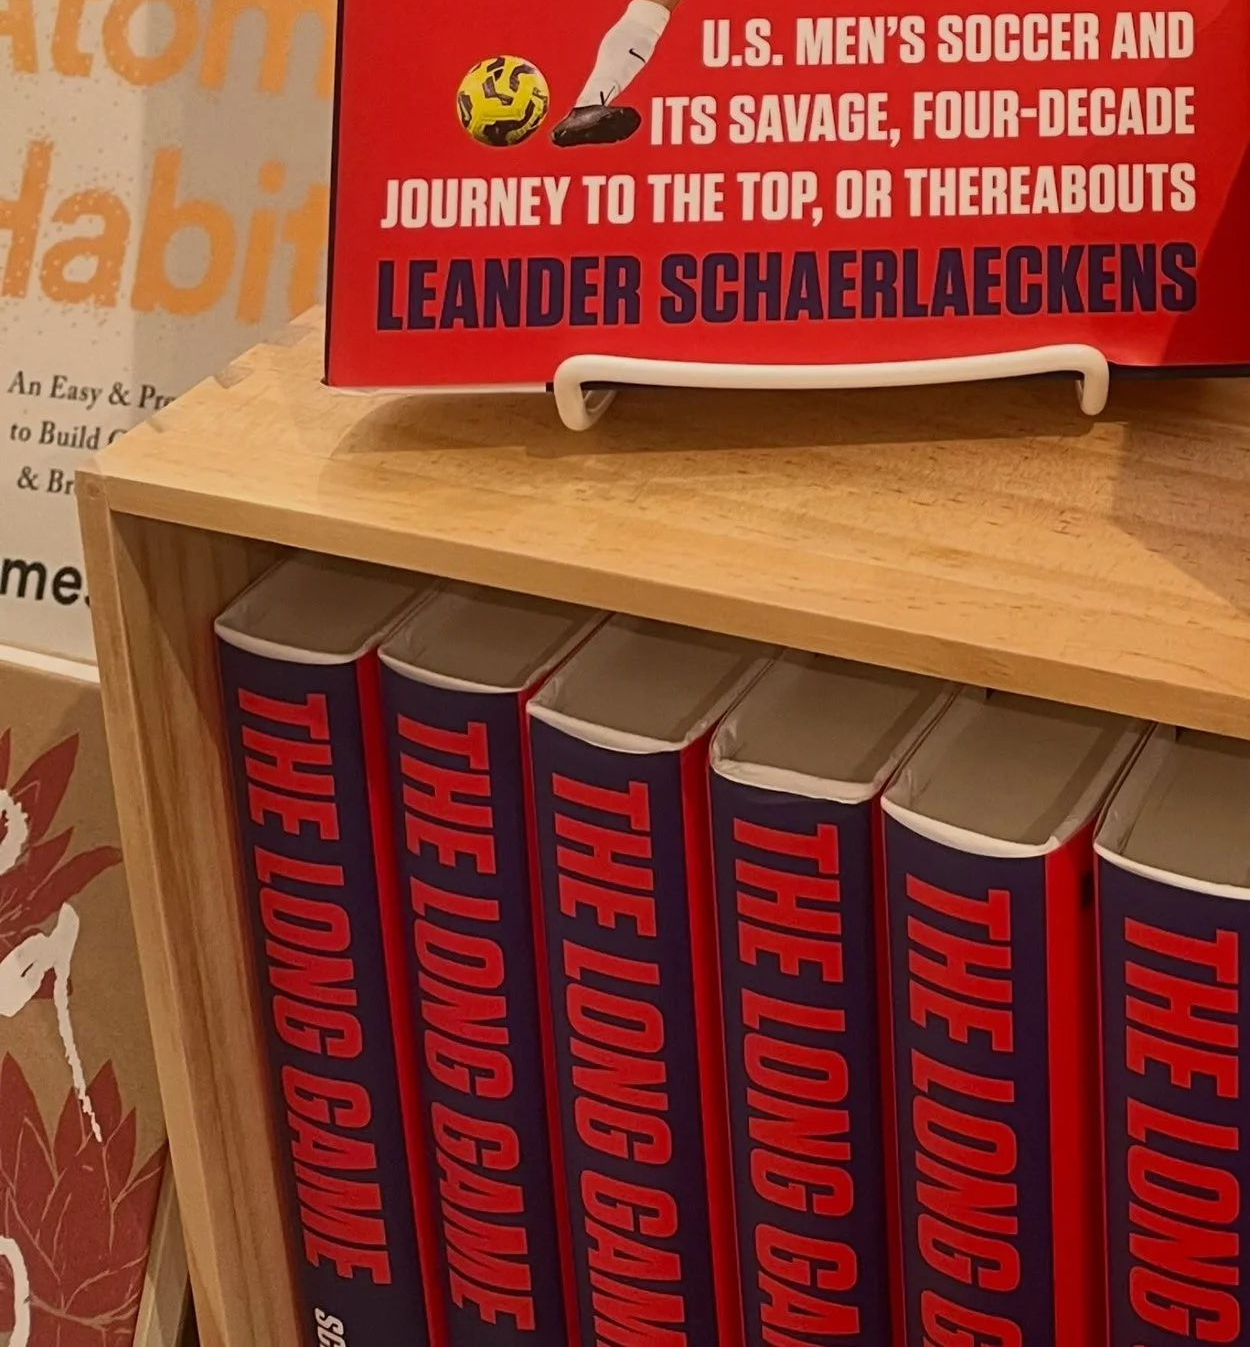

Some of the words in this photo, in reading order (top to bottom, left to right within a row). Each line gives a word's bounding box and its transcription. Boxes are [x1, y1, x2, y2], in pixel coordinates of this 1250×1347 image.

[651, 95, 717, 146] ITS
[729, 92, 900, 148] SAVAGE,
[913, 86, 1197, 141] FOUR-DECADE
[703, 18, 783, 69] U.S.
[795, 14, 926, 66] MEN’S
[937, 13, 1100, 63] SOCCER
[1111, 10, 1196, 60] AND
[380, 175, 572, 230] JOURNEY
[582, 174, 636, 226] TO
[647, 172, 725, 224] THE
[737, 170, 824, 228] TOP,
[836, 168, 893, 220] OR
[904, 162, 1197, 217] THEREABOUTS
[376, 254, 642, 332] LEANDER
[660, 242, 1198, 327] SCHAERLAECKENS
[8, 370, 42, 397] An
[50, 374, 103, 410] Easy
[108, 381, 131, 406] &
[10, 422, 31, 442] to
[38, 420, 101, 451] Build
[17, 466, 39, 491] &
[0, 556, 91, 608] me
[238, 688, 342, 842] THE
[397, 713, 496, 875] THE
[553, 772, 658, 938] THE
[733, 817, 844, 983] THE
[254, 844, 364, 1059] LONG
[410, 877, 514, 1099] LONG
[906, 872, 1014, 1052] THE
[1124, 916, 1239, 1100] THE
[563, 939, 672, 1165] LONG
[741, 986, 855, 1218] LONG
[281, 1065, 392, 1285] GAME
[432, 1100, 536, 1331] GAME
[911, 1048, 1021, 1293] LONG
[1127, 1096, 1241, 1344] LONG
[755, 1223, 861, 1347] GA
